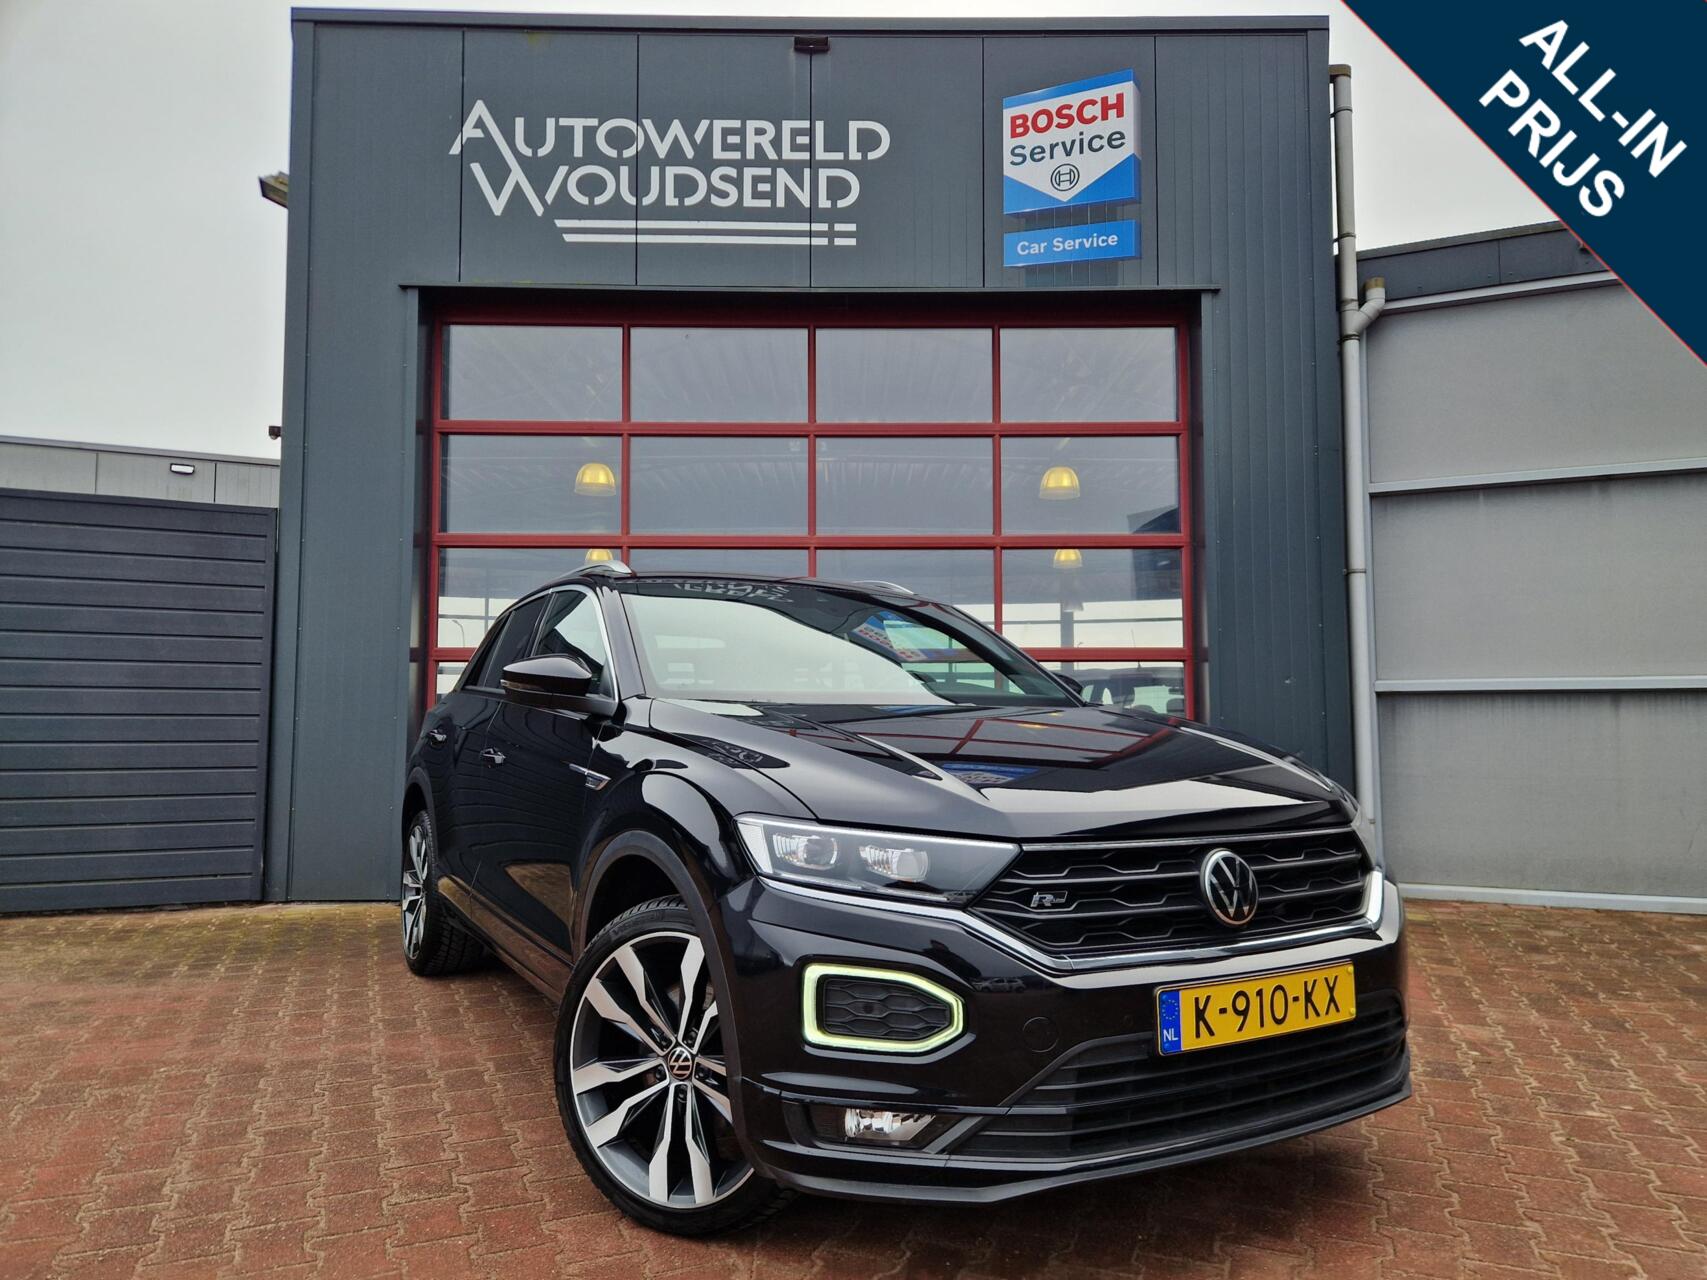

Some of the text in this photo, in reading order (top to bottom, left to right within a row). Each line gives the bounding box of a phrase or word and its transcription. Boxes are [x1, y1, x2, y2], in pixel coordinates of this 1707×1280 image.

[448, 99, 892, 161] AUTOWERELD
[1009, 91, 1125, 139] BOSCH
[1009, 130, 1126, 167] Service
[469, 161, 861, 217] WOUDSEND
[1016, 232, 1119, 256] Car Service
[1162, 974, 1341, 1042] NL K-910-KX
